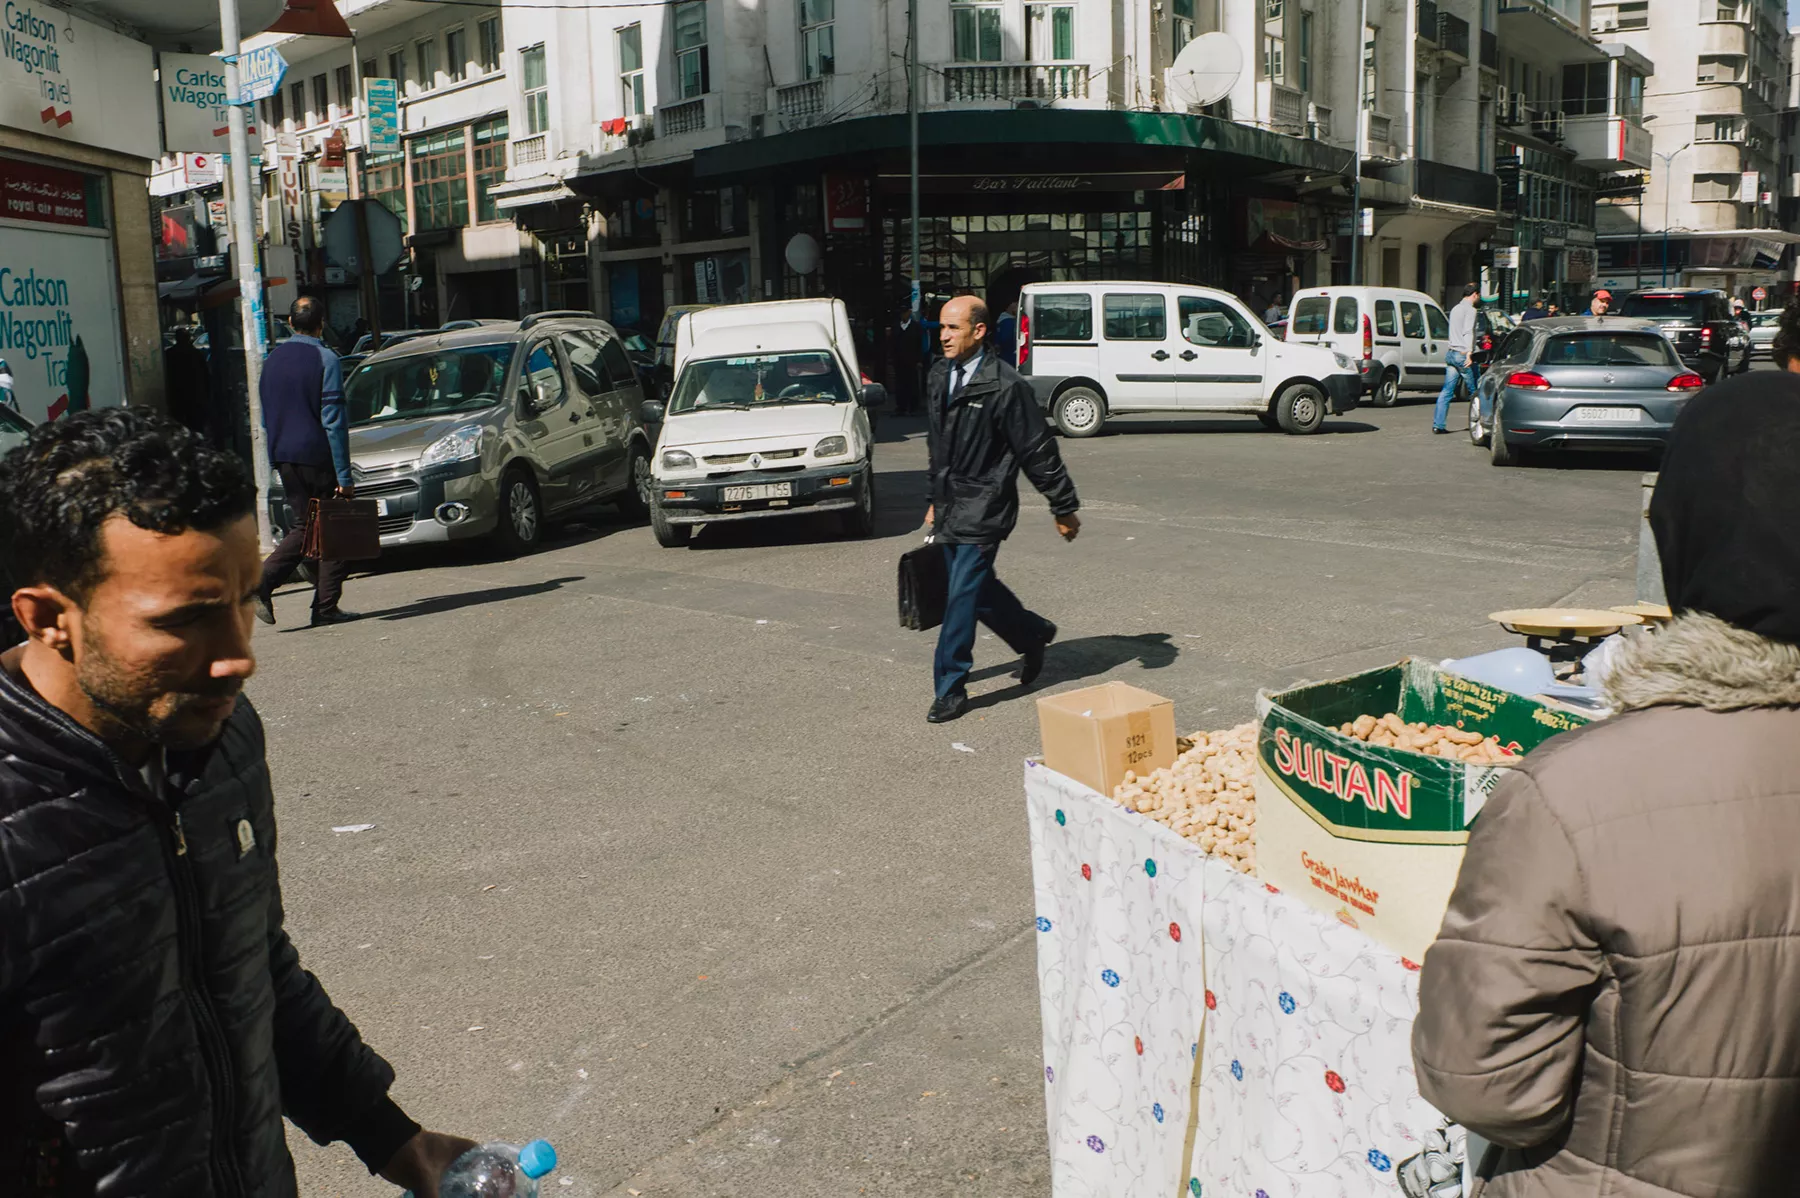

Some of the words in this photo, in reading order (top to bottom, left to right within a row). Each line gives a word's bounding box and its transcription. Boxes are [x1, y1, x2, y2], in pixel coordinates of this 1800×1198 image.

[5, 1, 57, 44] Carlson
[0, 28, 61, 74] Wagonlit
[35, 71, 72, 105] Travel
[176, 68, 227, 88] Carlso
[168, 86, 227, 109] Wagon
[211, 106, 256, 124] Trel
[8, 198, 35, 213] royal
[37, 203, 52, 215] air
[55, 205, 84, 218] maroc
[0, 267, 69, 307] Carlson
[41, 352, 69, 387] Tra
[1126, 733, 1145, 749] 8121
[1128, 750, 1153, 764] 12pcs
[1274, 727, 1413, 820] SULTAN
[1301, 850, 1333, 882] Grain
[1333, 867, 1379, 904] Jawhar
